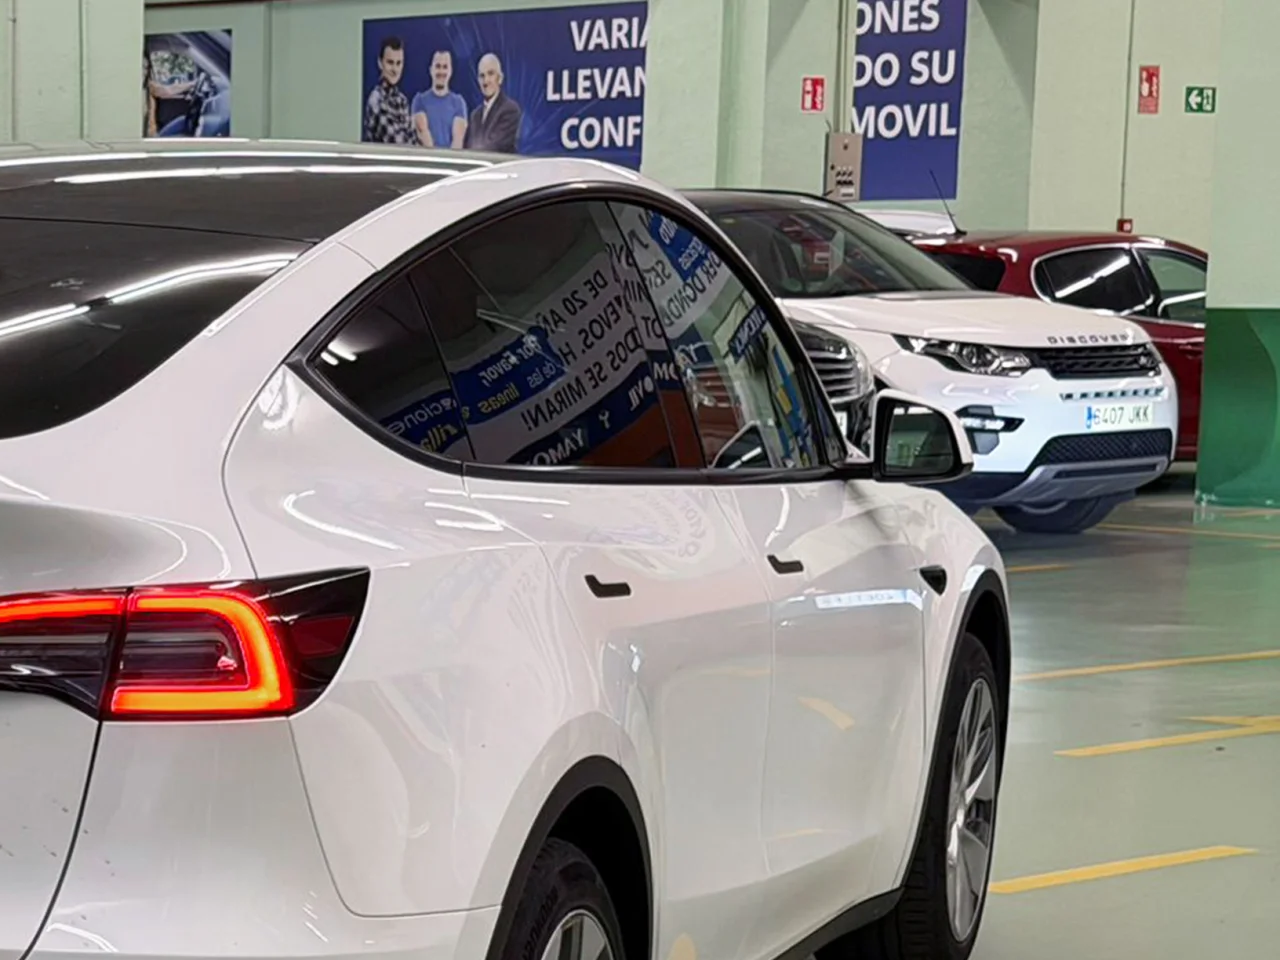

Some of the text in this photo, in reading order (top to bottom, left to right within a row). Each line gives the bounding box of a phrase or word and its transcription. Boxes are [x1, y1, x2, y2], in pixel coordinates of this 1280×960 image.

[856, 0, 940, 35] ONES
[854, 49, 956, 87] DO SU
[560, 115, 642, 150] CONF
[851, 102, 957, 139] MOVIL
